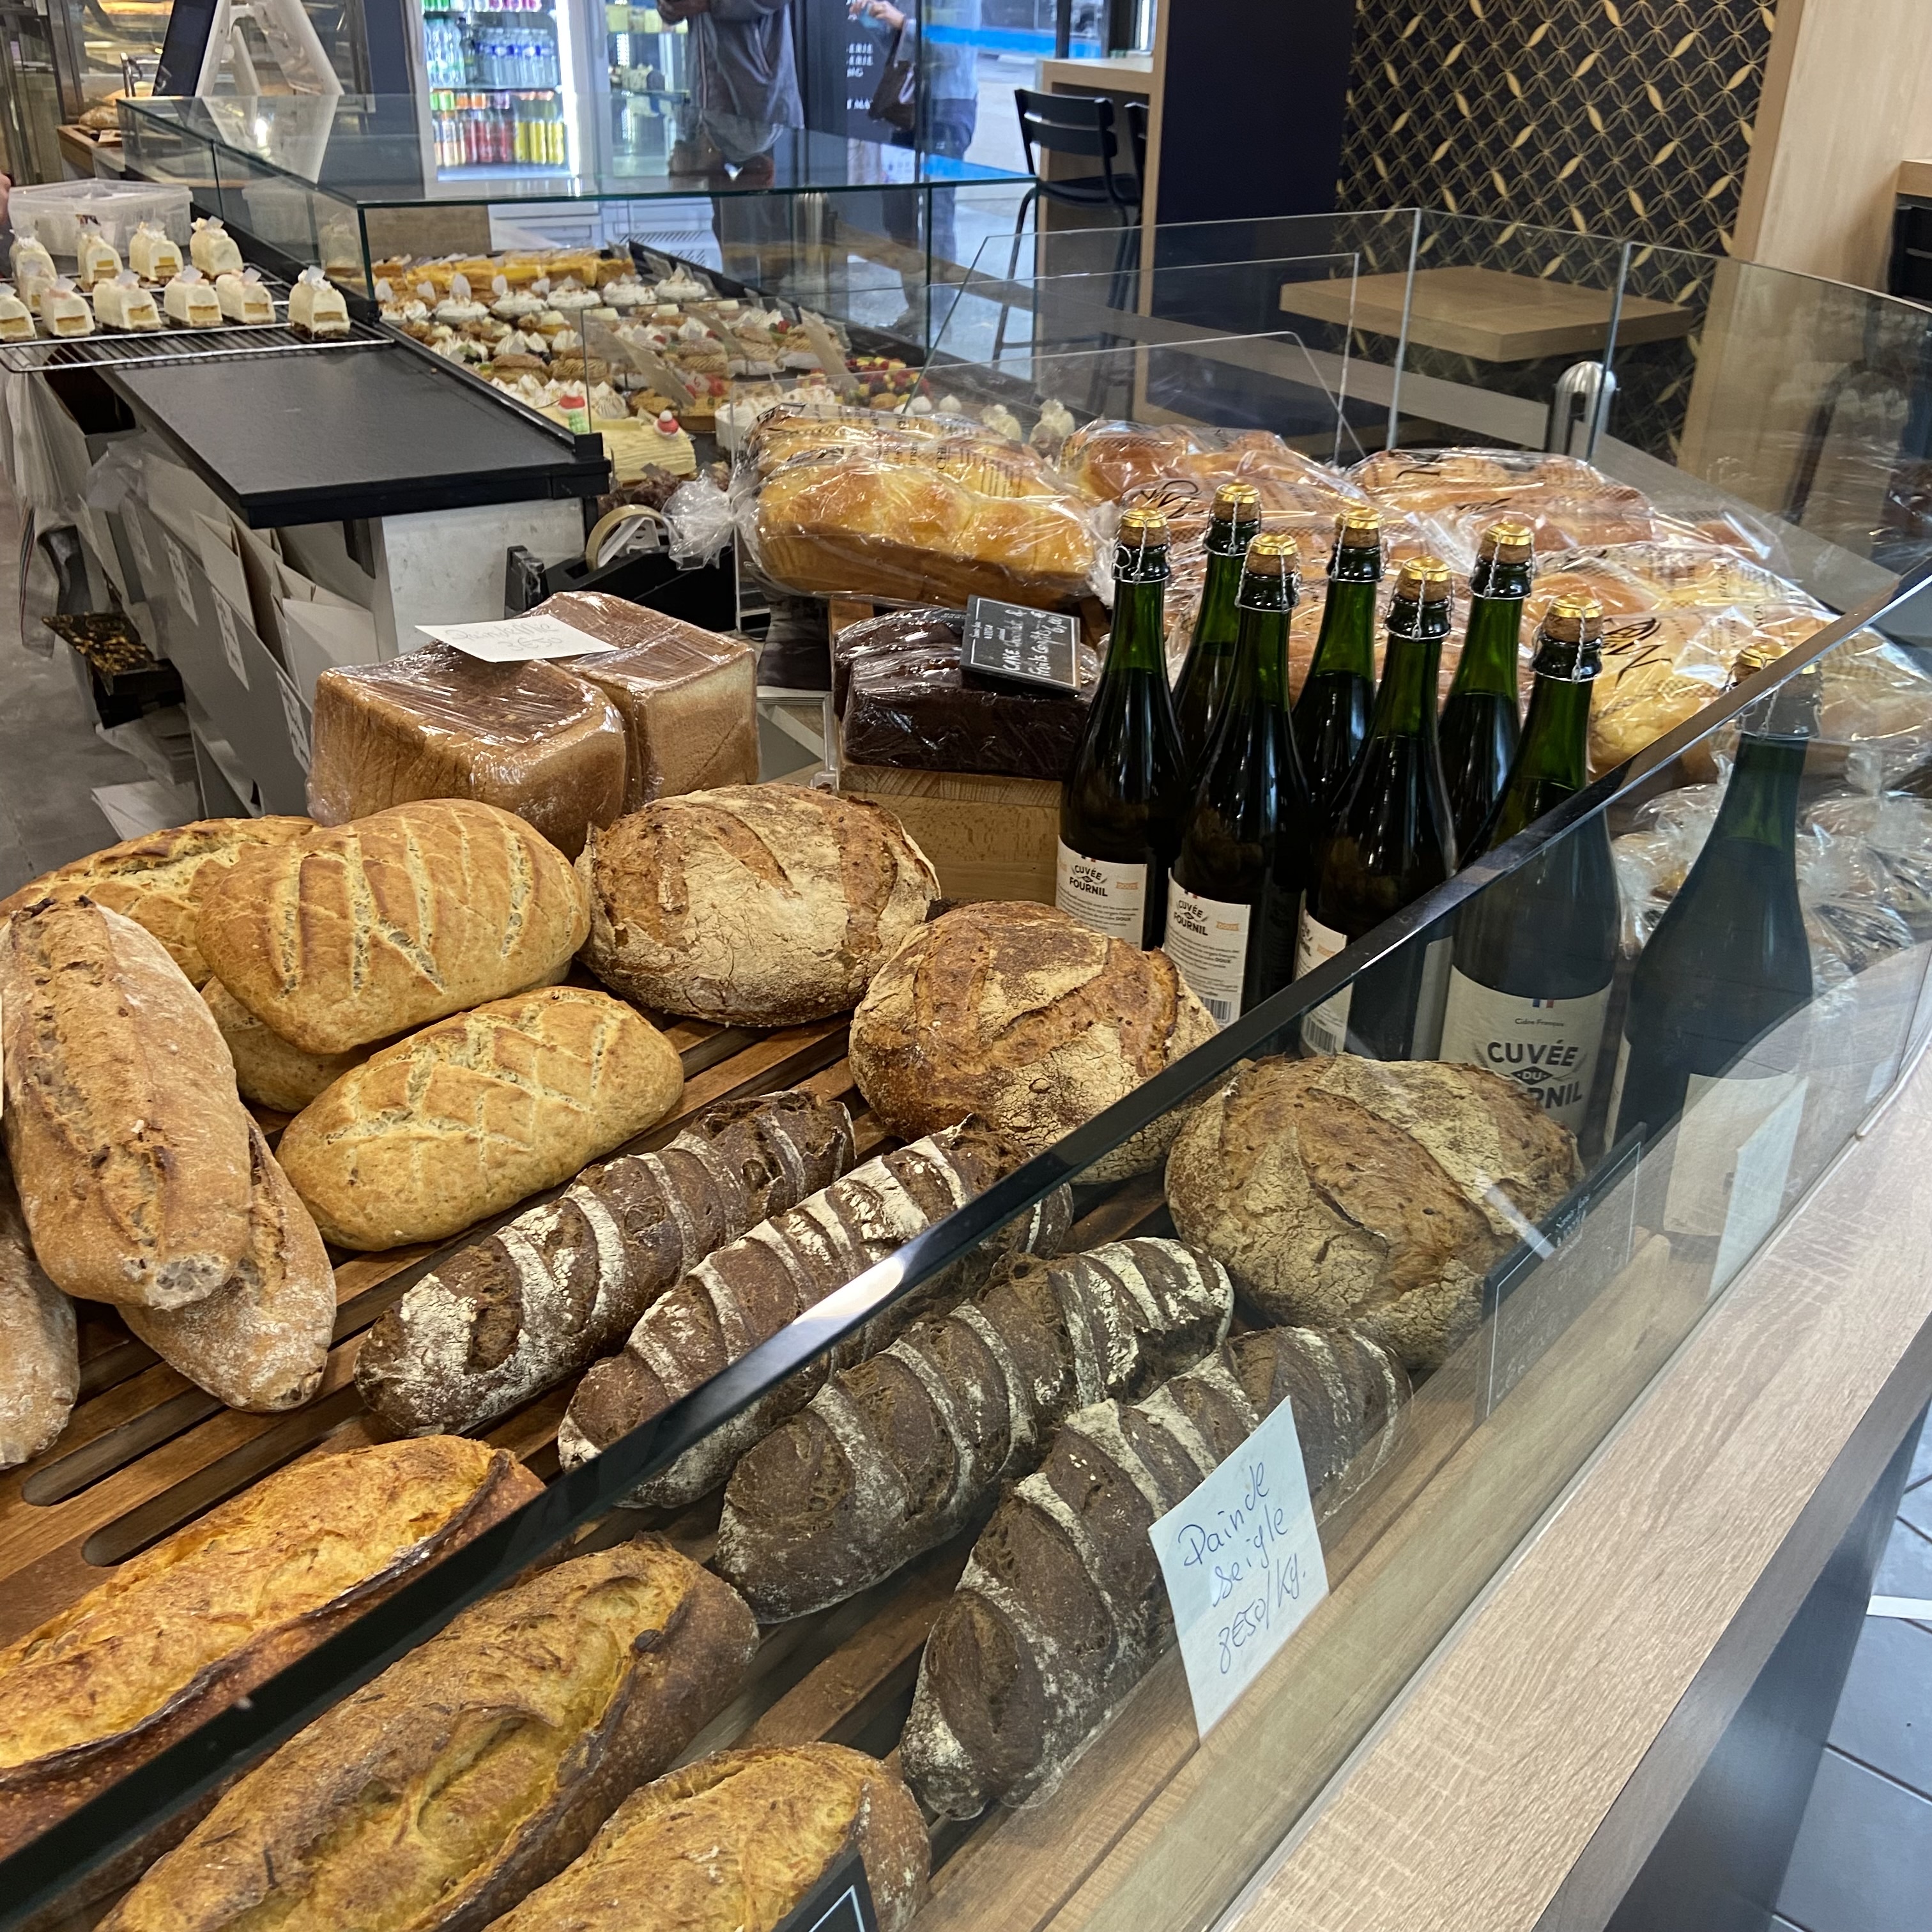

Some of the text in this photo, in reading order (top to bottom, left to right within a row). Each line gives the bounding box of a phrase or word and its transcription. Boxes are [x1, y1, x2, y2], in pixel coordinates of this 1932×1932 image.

[1075, 864, 1102, 880] CUVÉE
[1070, 876, 1108, 897] FOURNIL
[1178, 900, 1203, 918] CUVÉE
[1174, 911, 1209, 936] FOURNIL
[1487, 1039, 1579, 1067] CUVÉE
[1521, 1071, 1542, 1080] DU
[1177, 1506, 1245, 1567] Pain
[1213, 1504, 1289, 1608] seigle
